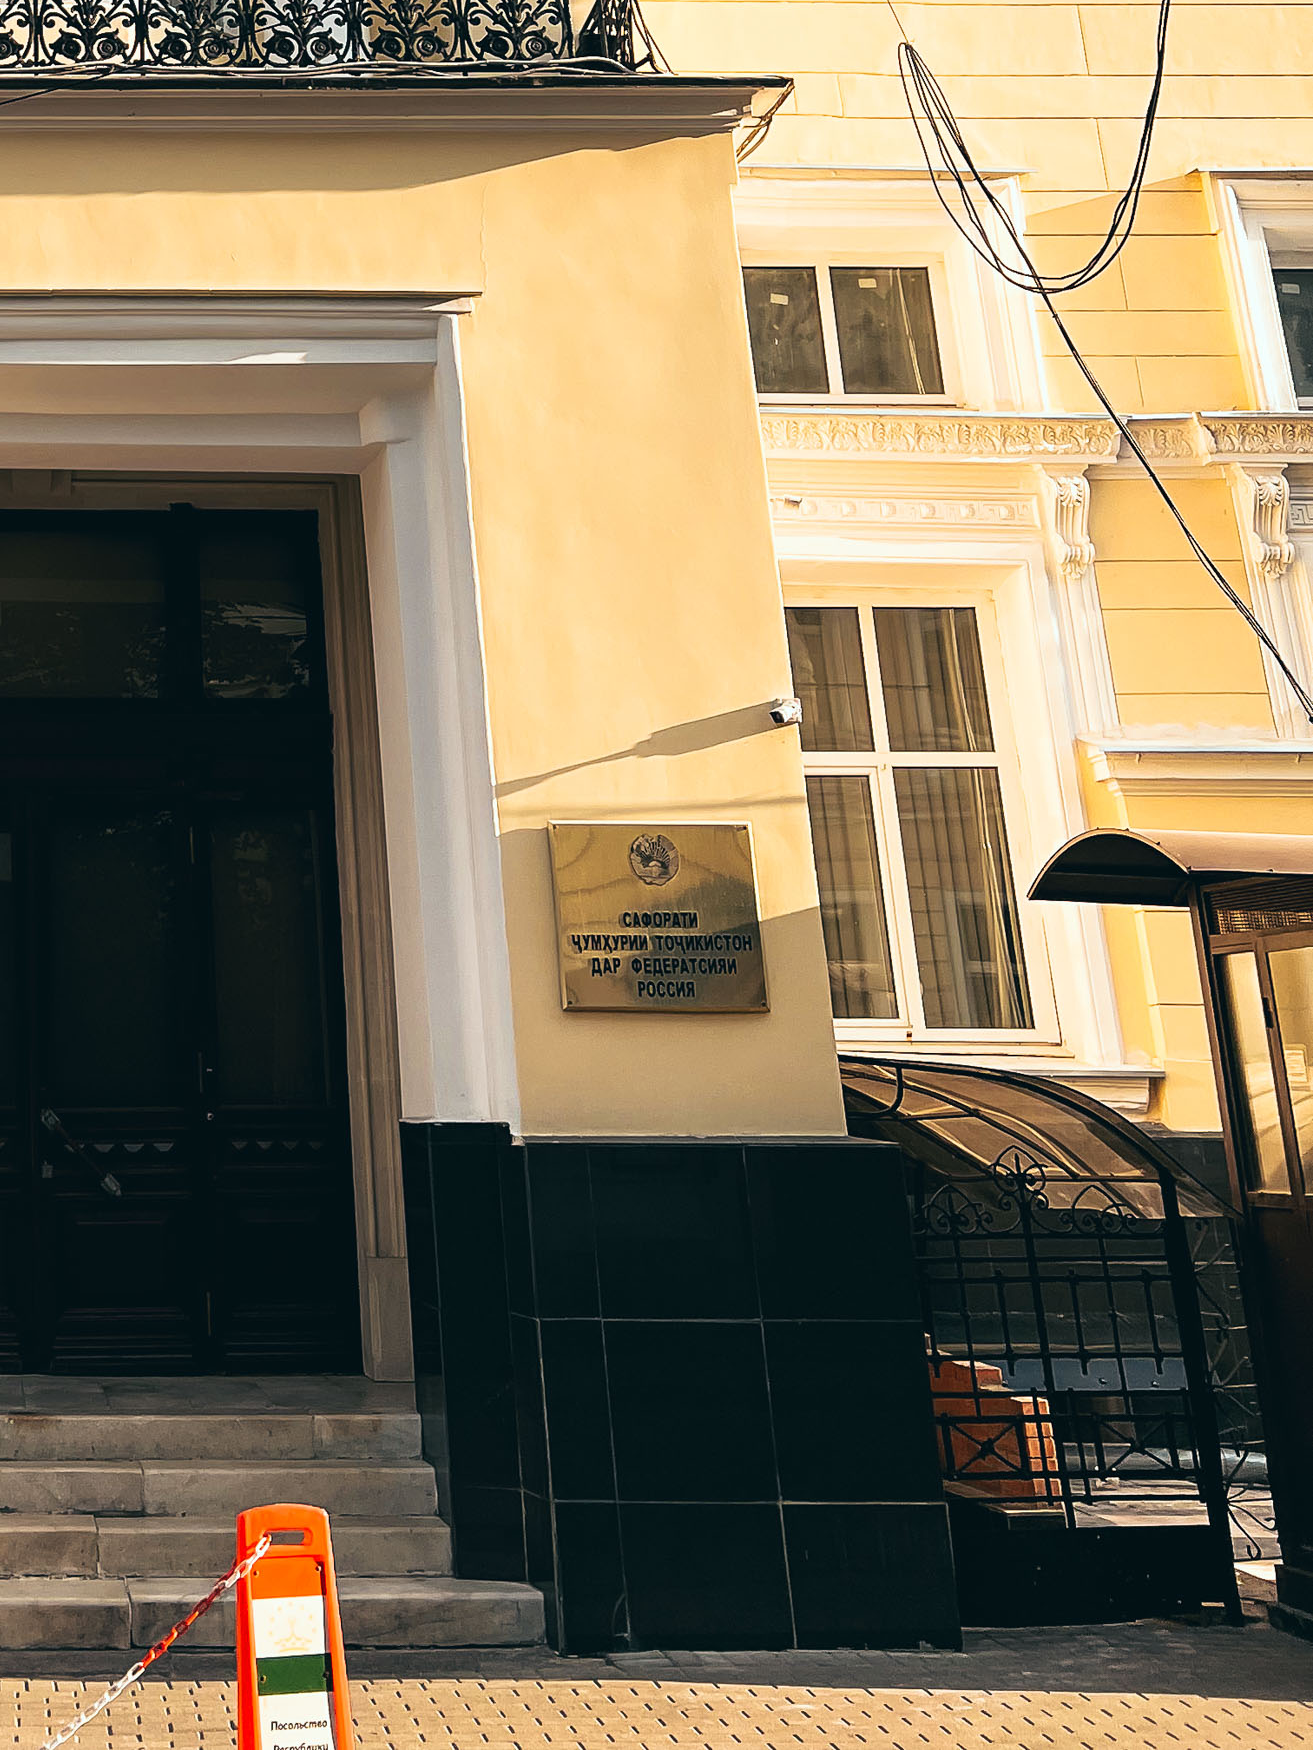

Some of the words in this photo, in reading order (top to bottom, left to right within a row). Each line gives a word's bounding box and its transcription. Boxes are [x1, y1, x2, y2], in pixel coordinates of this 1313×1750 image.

[622, 911, 698, 929] САФОРАТИ
[591, 957, 622, 977] ДАР
[631, 957, 738, 977] ФЕДЕРАТСИЯИ
[637, 981, 696, 998] РОССИЯ
[270, 1720, 328, 1731] Посольство
